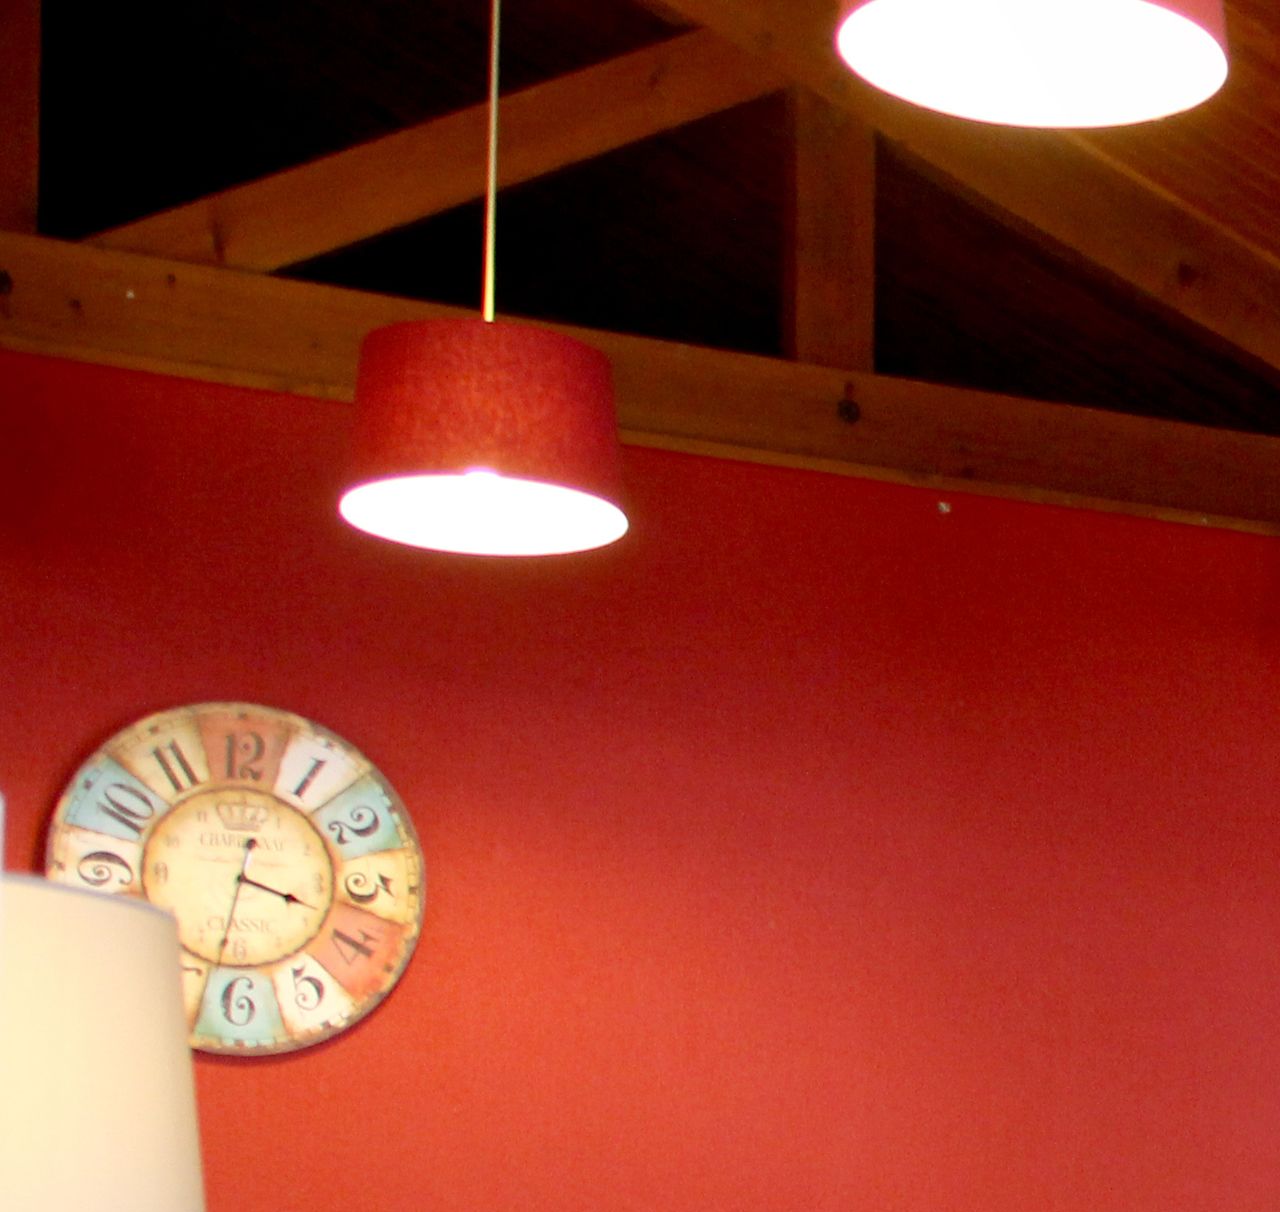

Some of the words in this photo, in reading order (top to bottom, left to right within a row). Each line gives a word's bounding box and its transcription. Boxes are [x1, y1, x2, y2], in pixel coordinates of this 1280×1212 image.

[152, 739, 199, 794] 11
[224, 731, 265, 781] 12
[292, 756, 327, 801] 1
[97, 782, 155, 836] 10
[328, 805, 380, 845] 2
[76, 851, 133, 887] 9
[344, 871, 396, 903] 3
[332, 927, 379, 966] 4
[221, 977, 256, 1027] 6
[292, 961, 325, 1010] 5
